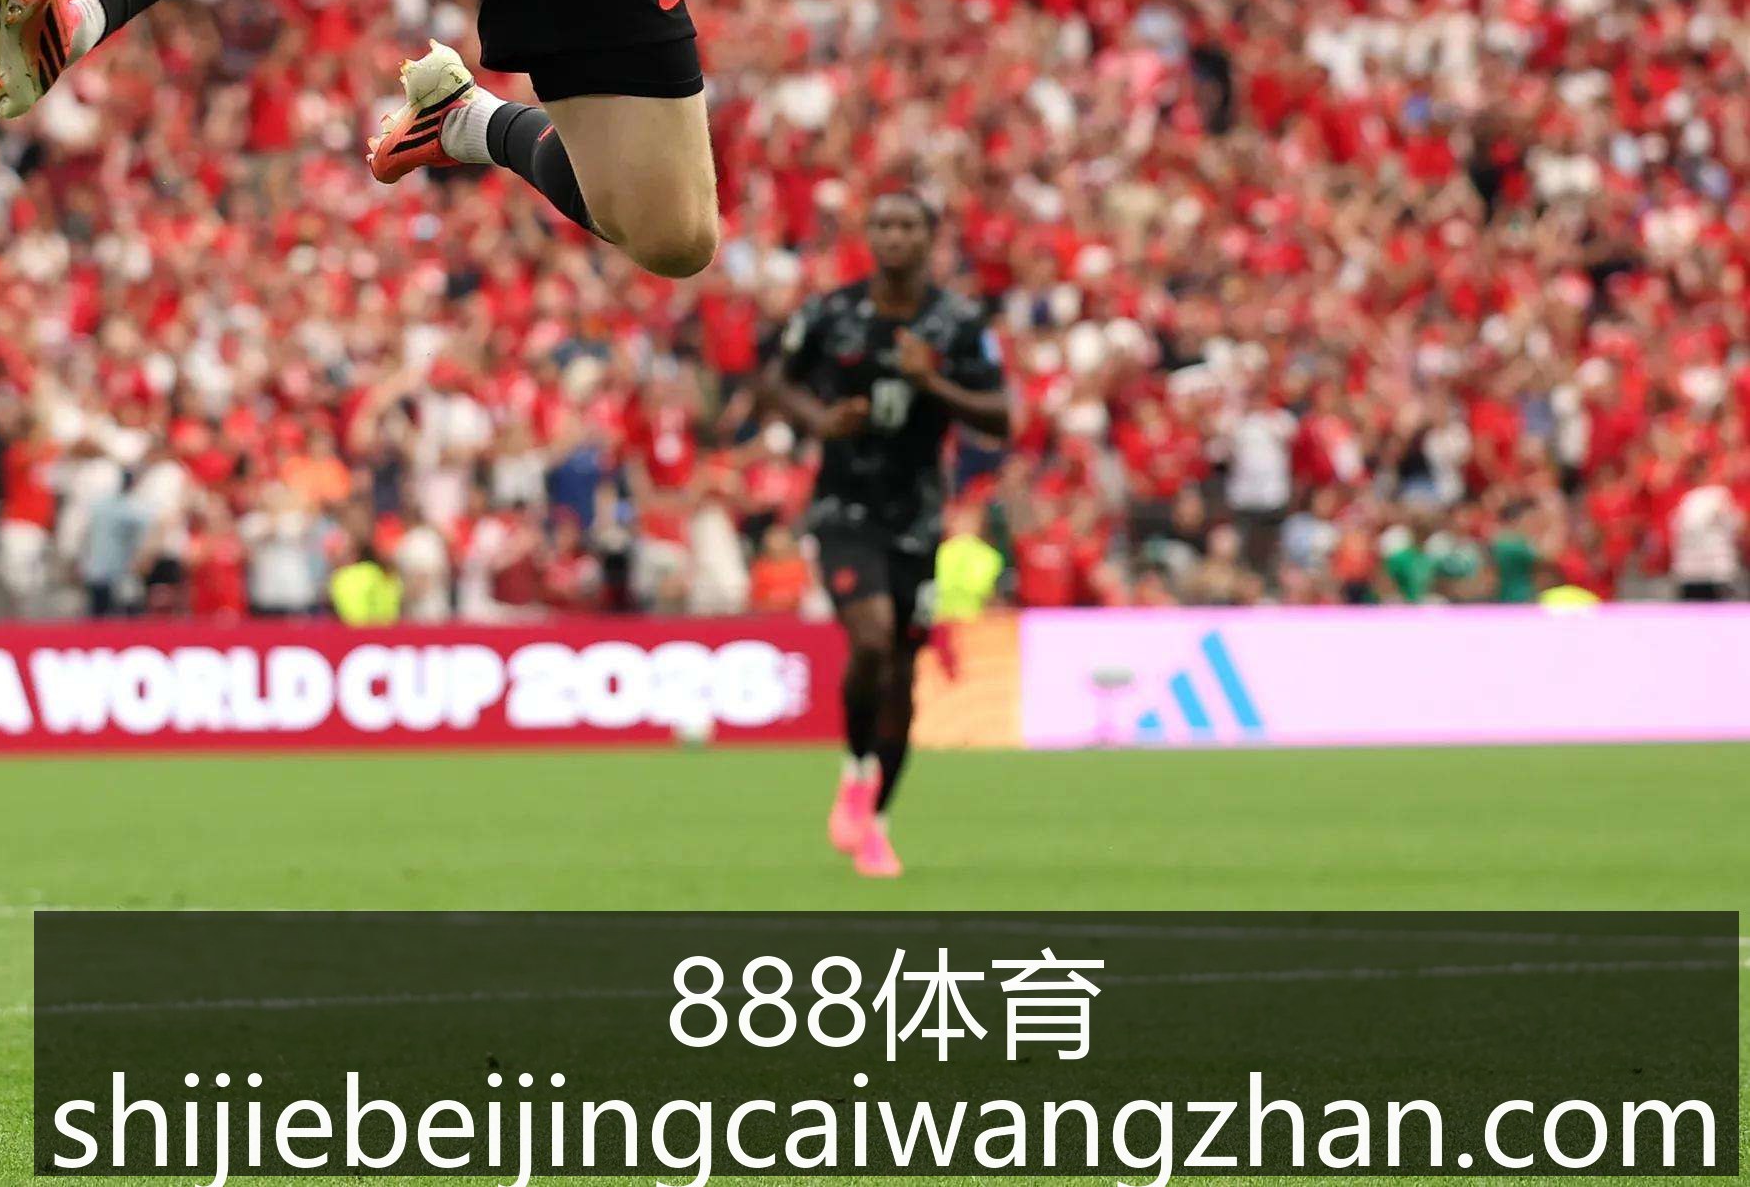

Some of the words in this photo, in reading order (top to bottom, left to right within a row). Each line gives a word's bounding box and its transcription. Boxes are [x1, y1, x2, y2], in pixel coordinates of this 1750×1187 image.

[28, 644, 335, 734] WORLD
[336, 643, 507, 732] CUP
[505, 640, 787, 728] 2026
